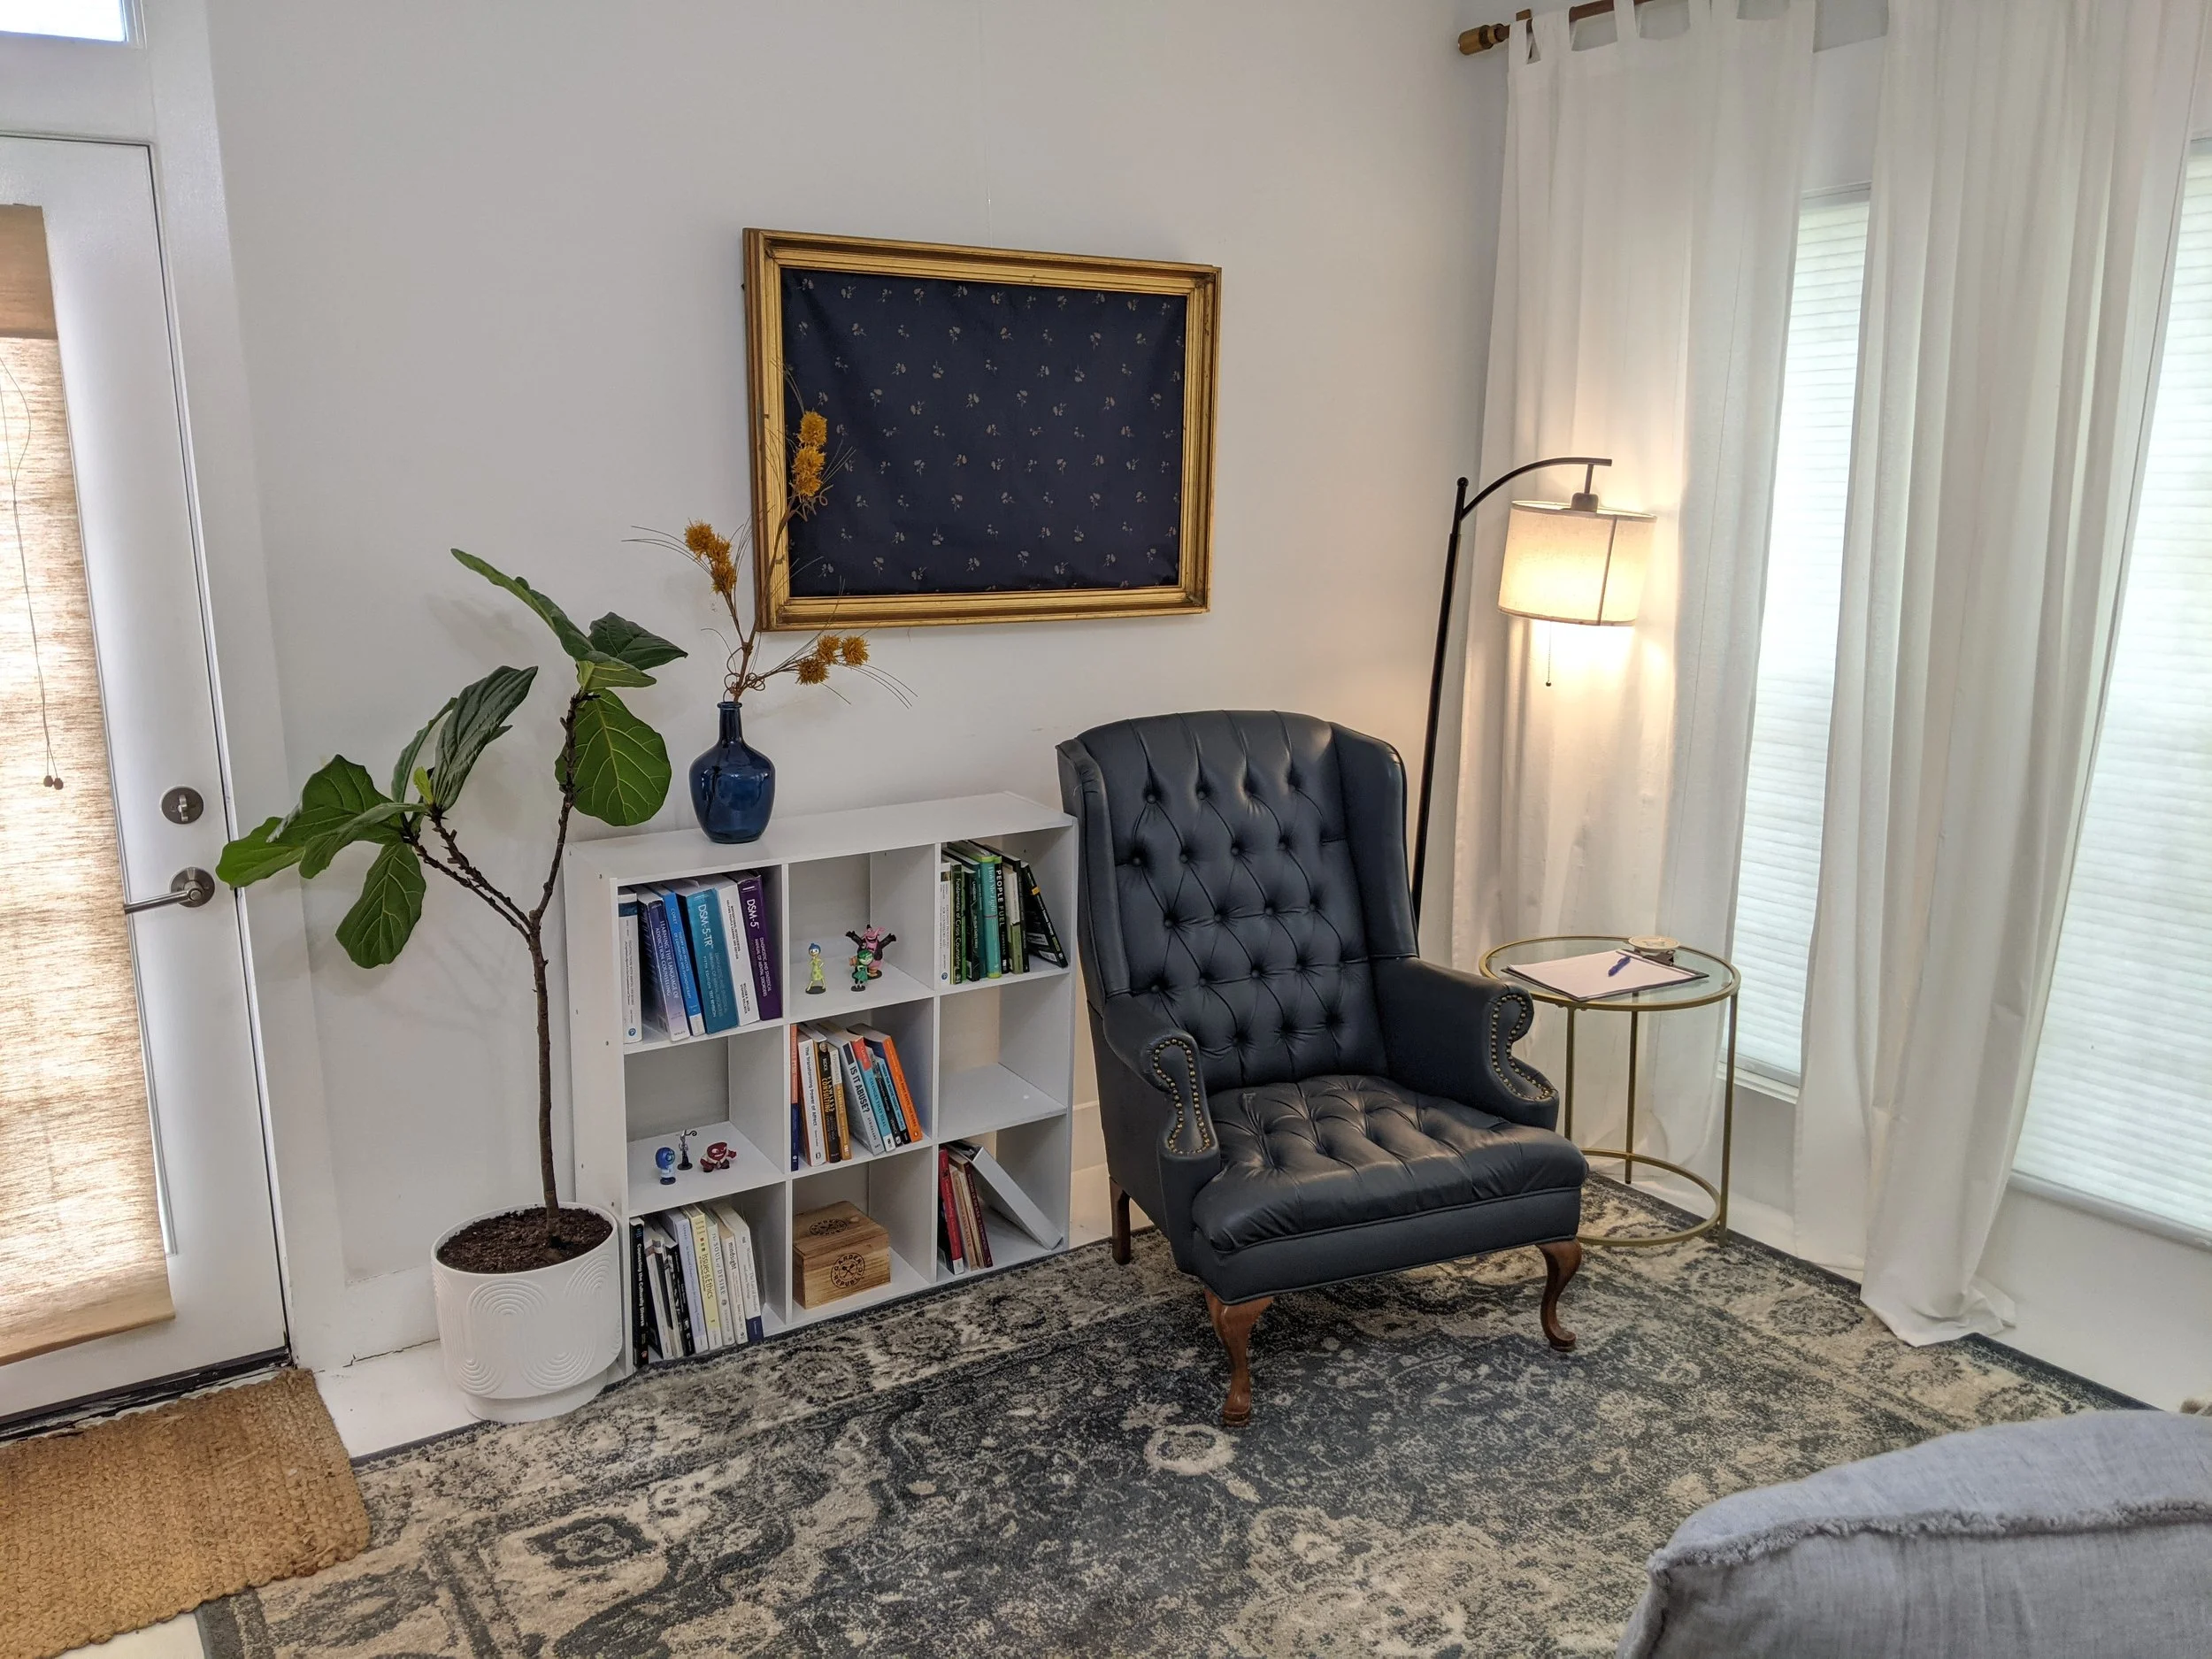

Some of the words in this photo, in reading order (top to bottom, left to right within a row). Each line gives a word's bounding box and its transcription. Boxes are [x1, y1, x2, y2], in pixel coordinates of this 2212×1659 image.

[655, 927, 665, 960] ADDICTION
[661, 960, 672, 996] COUNSELING
[660, 921, 669, 949] LEARNING
[667, 962, 677, 992] LANGUAGE
[849, 1065, 858, 1075] IS
[852, 1075, 861, 1084] IT
[821, 1078, 831, 1112] CONSULTING
[826, 1076, 835, 1112] FLAWLESS
[855, 1084, 871, 1114] ABUSE?
[869, 1078, 879, 1101] CHANGES
[702, 1254, 710, 1273] Issues
[727, 1242, 736, 1270] mindsight
[833, 1254, 863, 1271] GARDEN
[705, 1279, 714, 1300] Ethics
